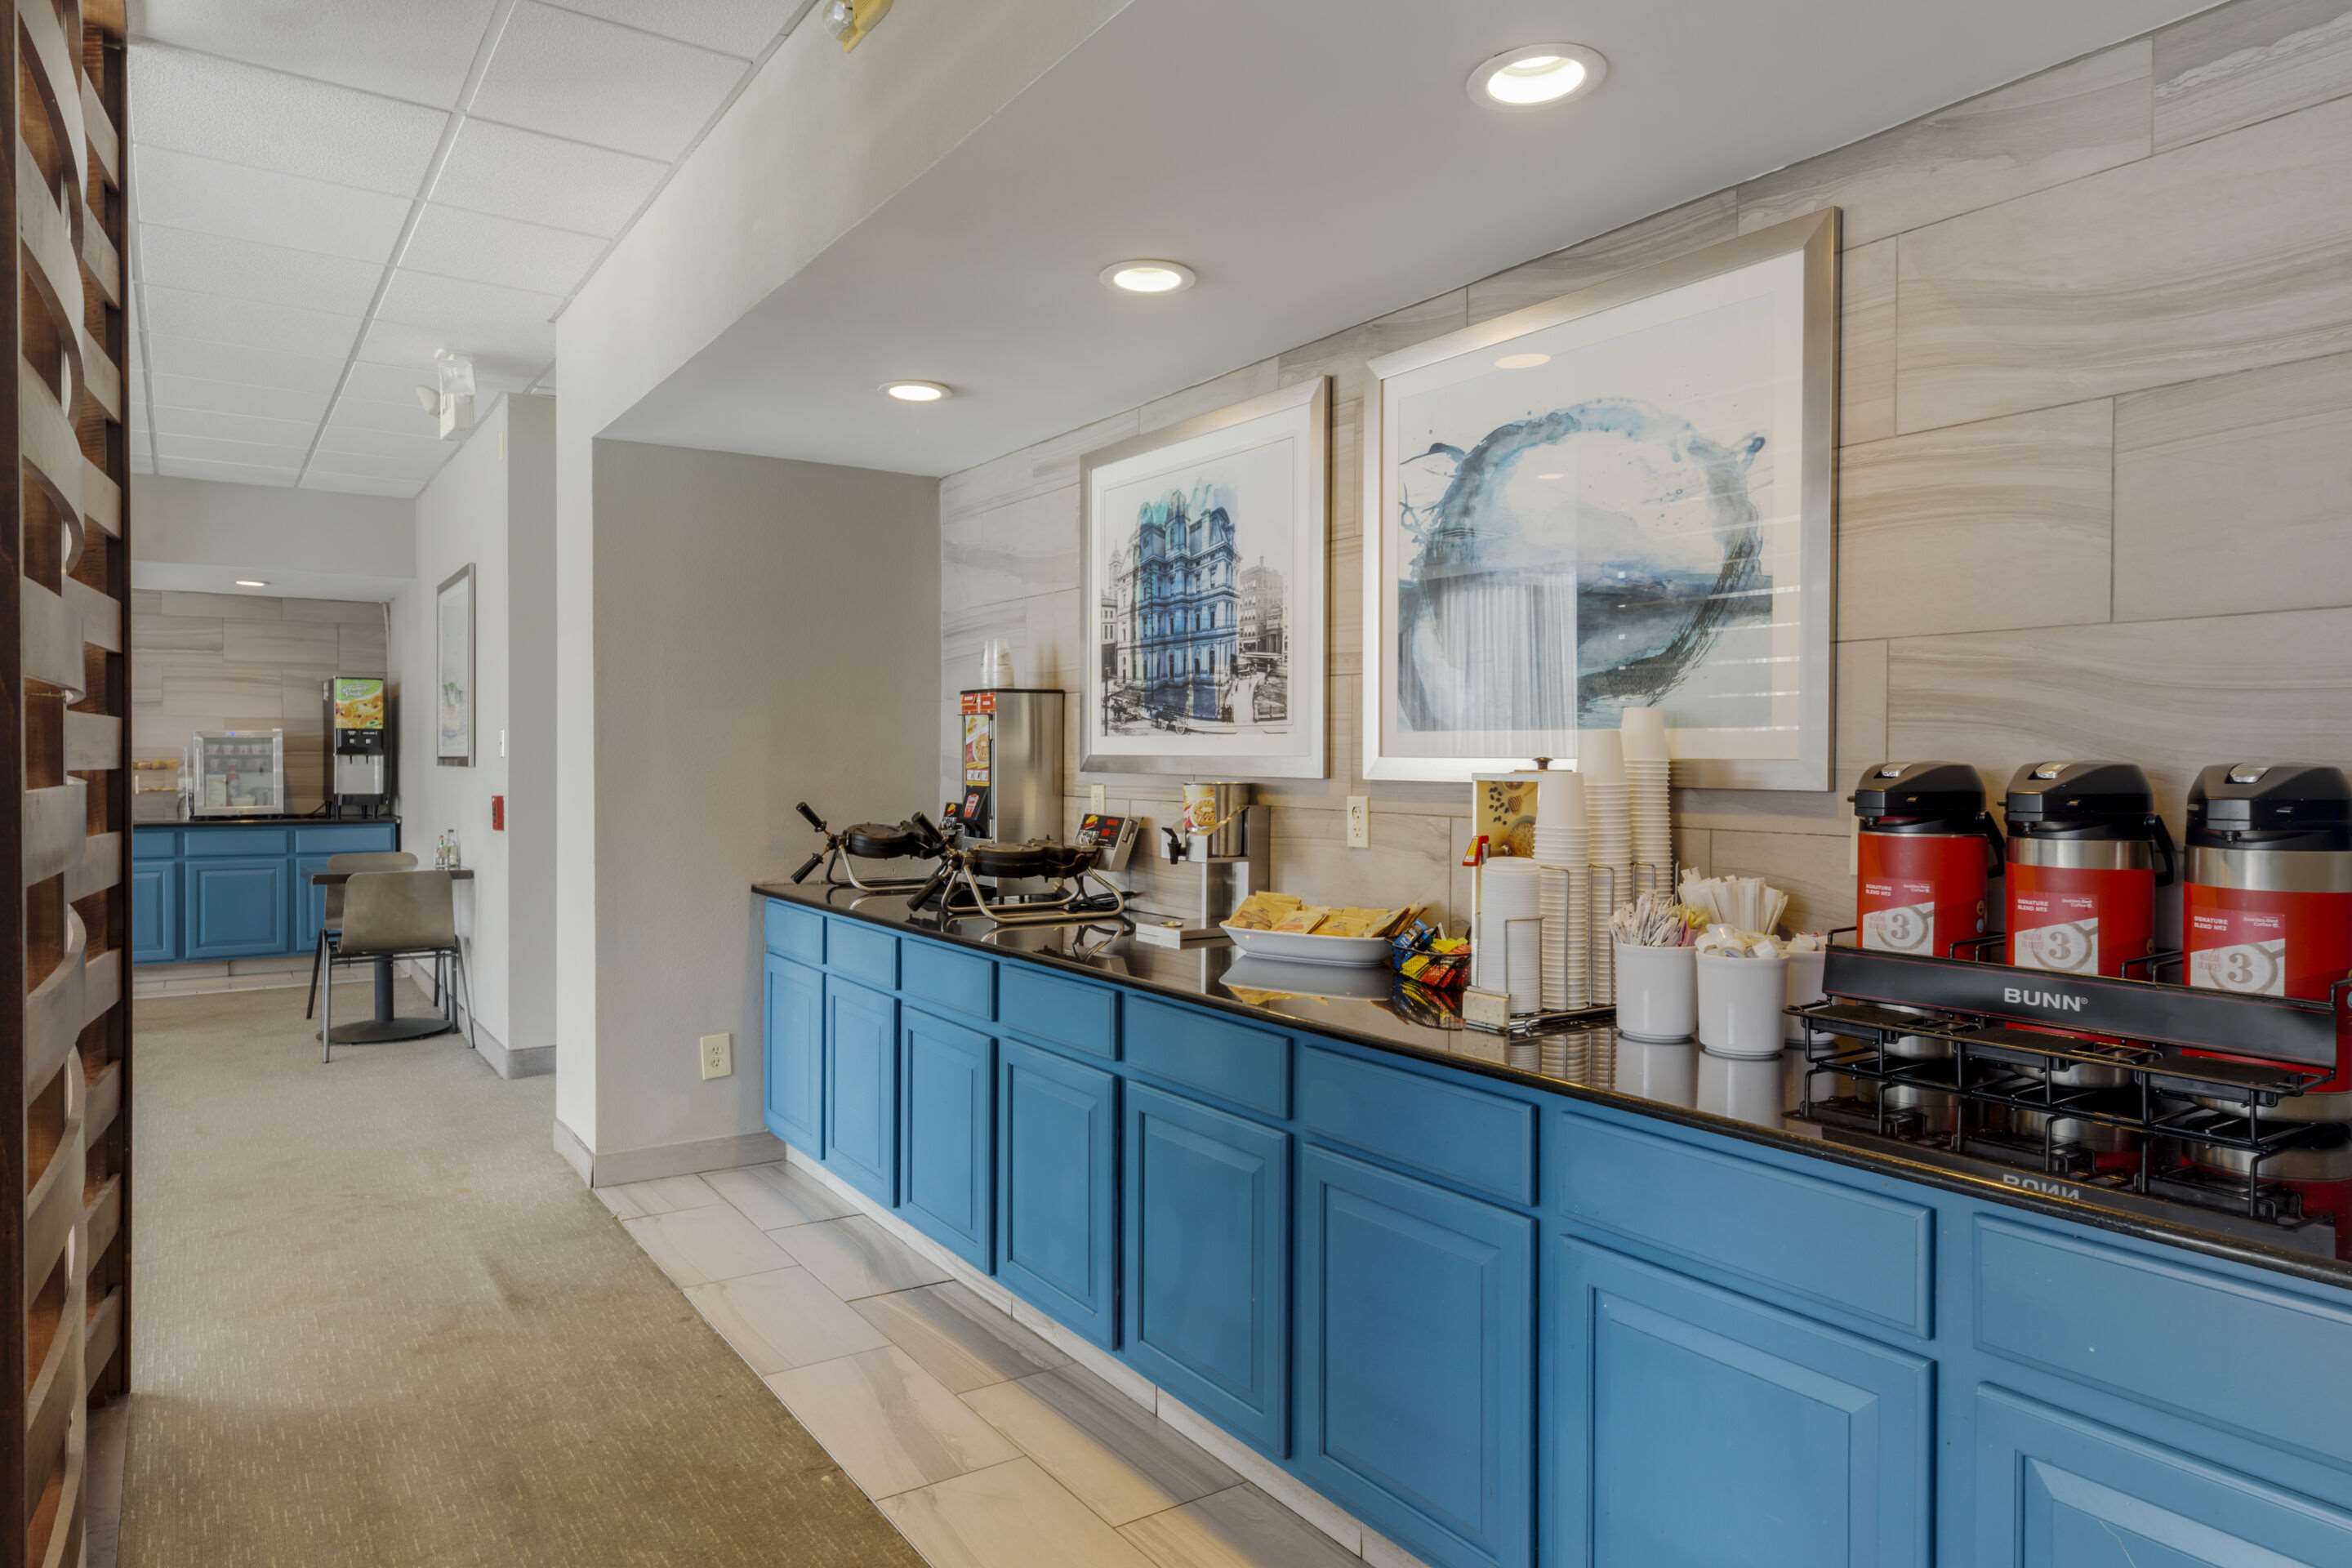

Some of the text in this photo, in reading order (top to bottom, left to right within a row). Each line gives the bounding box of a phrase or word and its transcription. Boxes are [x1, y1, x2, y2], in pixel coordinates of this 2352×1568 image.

[1891, 914, 1909, 940] 3
[2049, 931, 2071, 960] 3
[2227, 952, 2253, 984] 3
[2004, 987, 2081, 1012] BUNN
